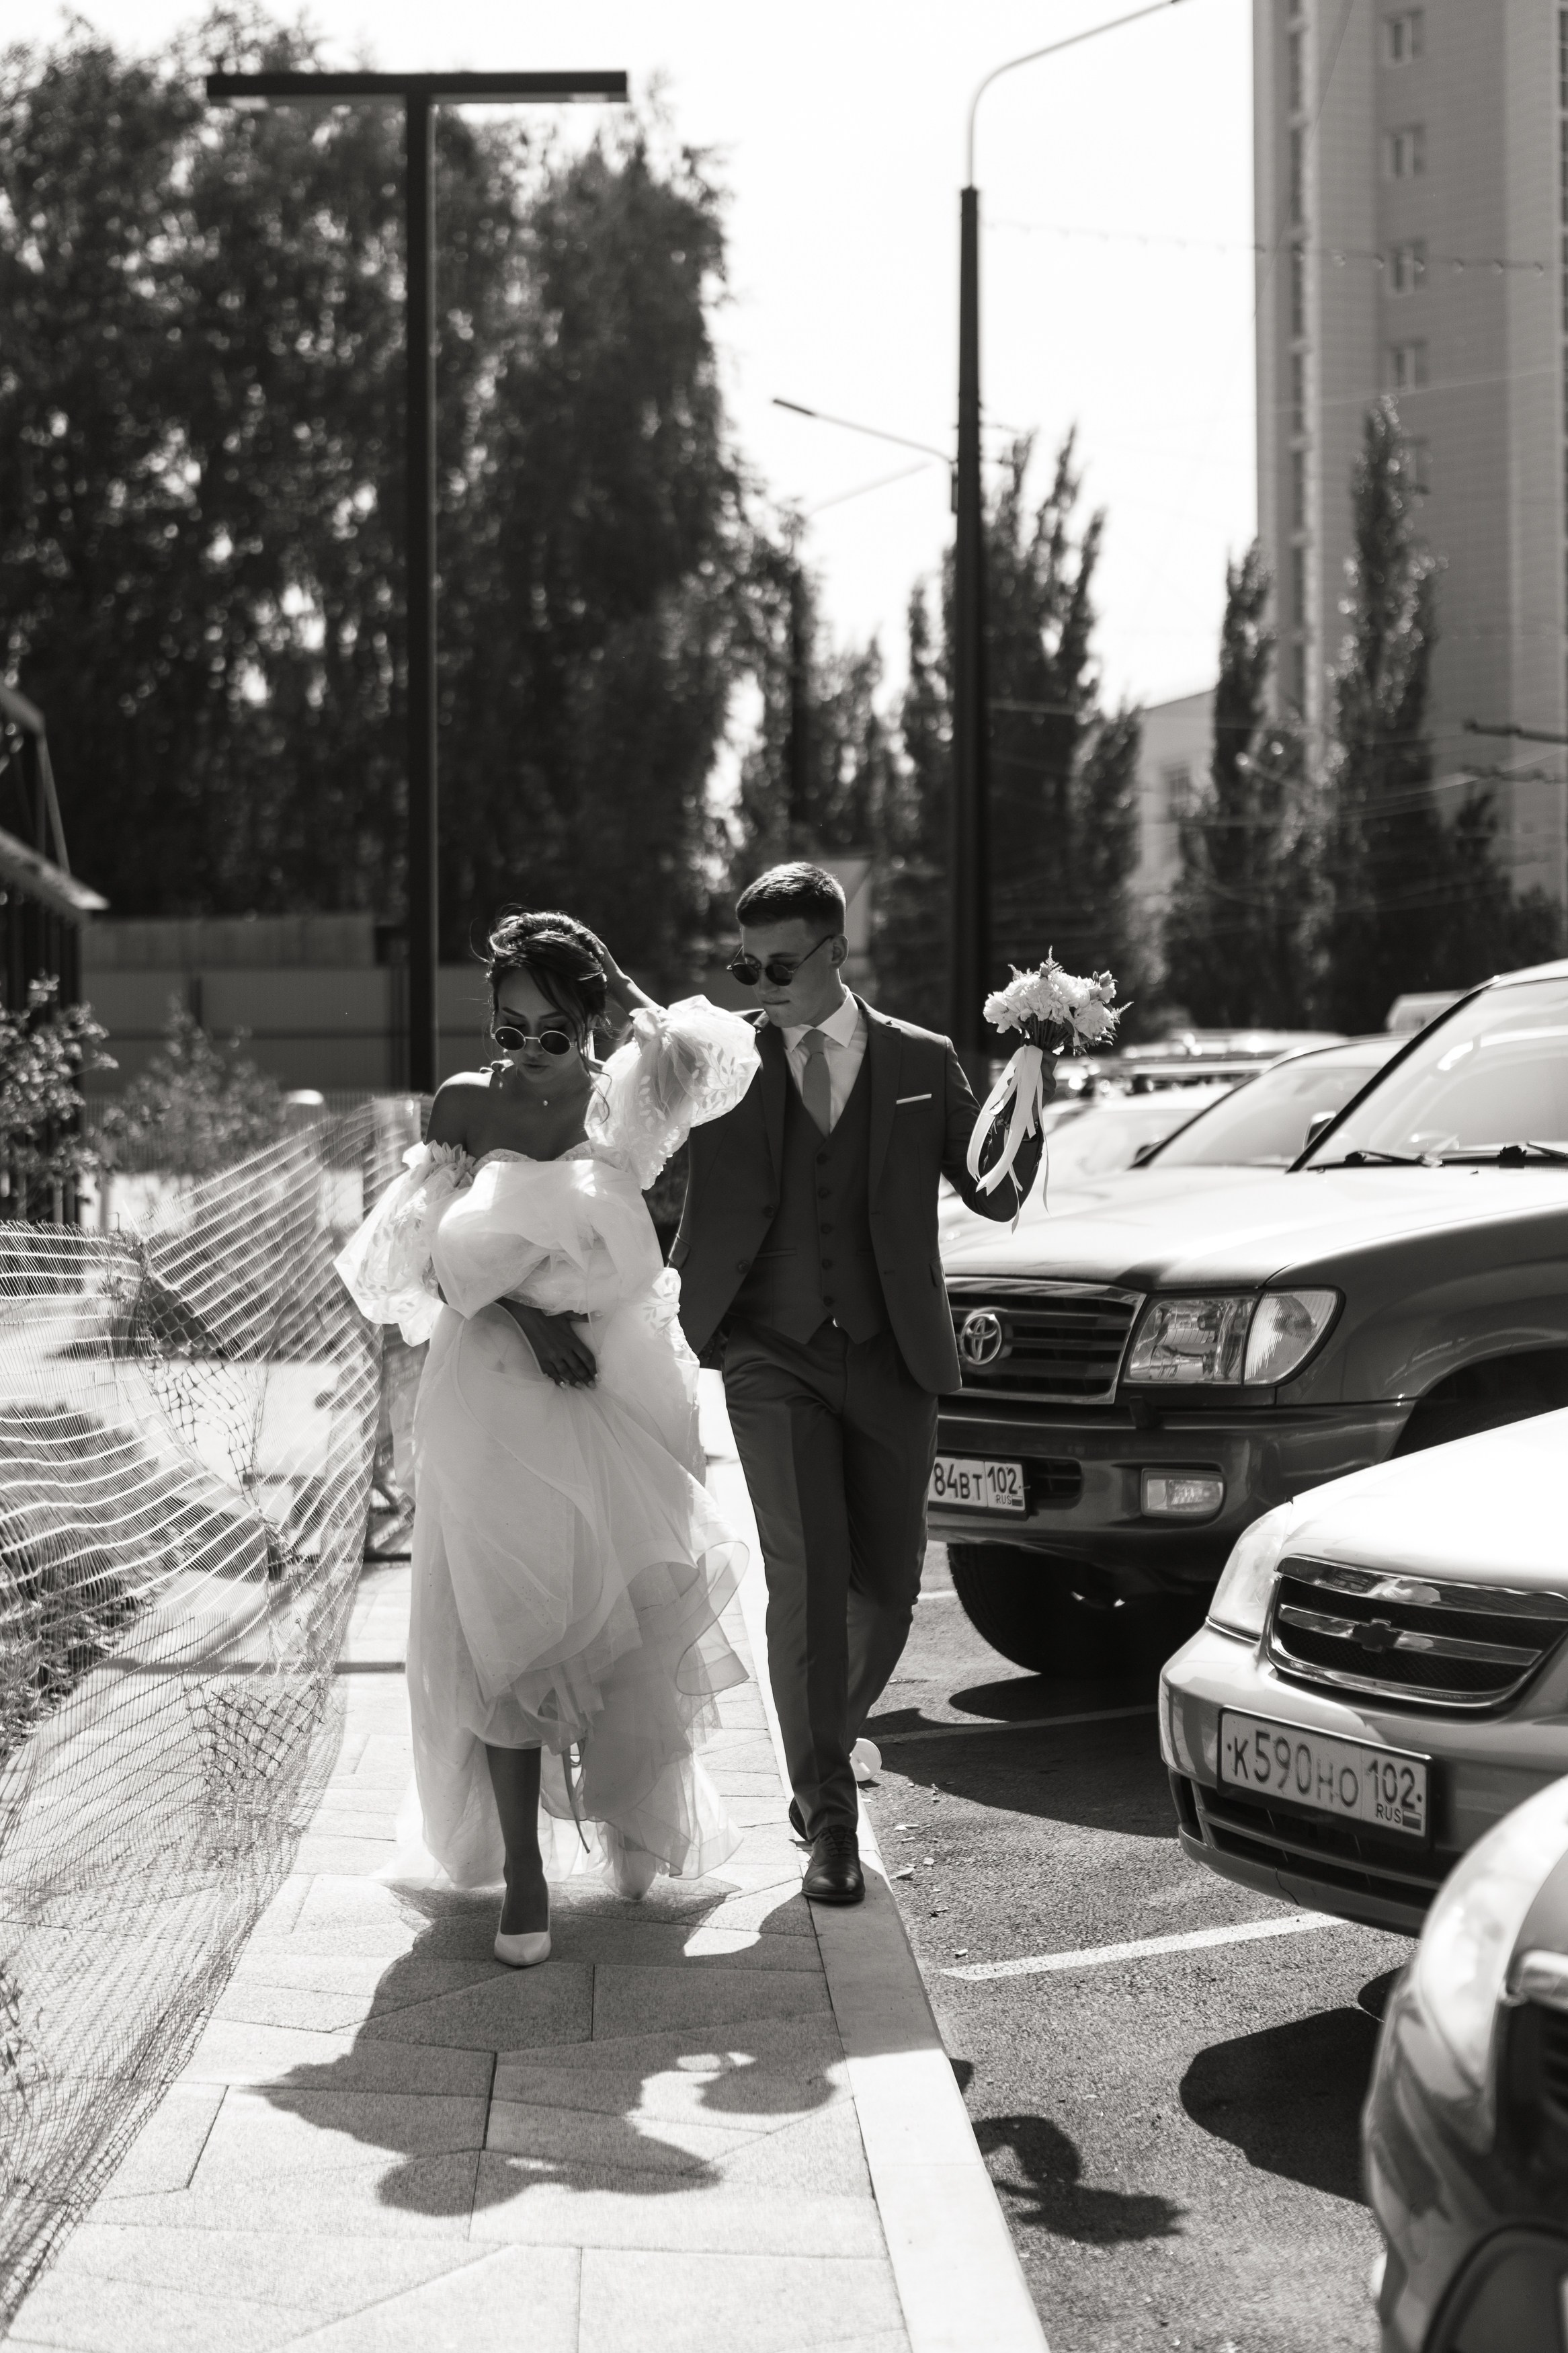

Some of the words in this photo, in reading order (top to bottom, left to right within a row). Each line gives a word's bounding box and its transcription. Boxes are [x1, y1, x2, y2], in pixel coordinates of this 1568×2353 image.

[934, 1462, 983, 1501] 84ВТ
[987, 1466, 1018, 1494] 102
[995, 1494, 1012, 1505] RUS
[1367, 1759, 1416, 1810] 102
[1376, 1802, 1402, 1824] RUS
